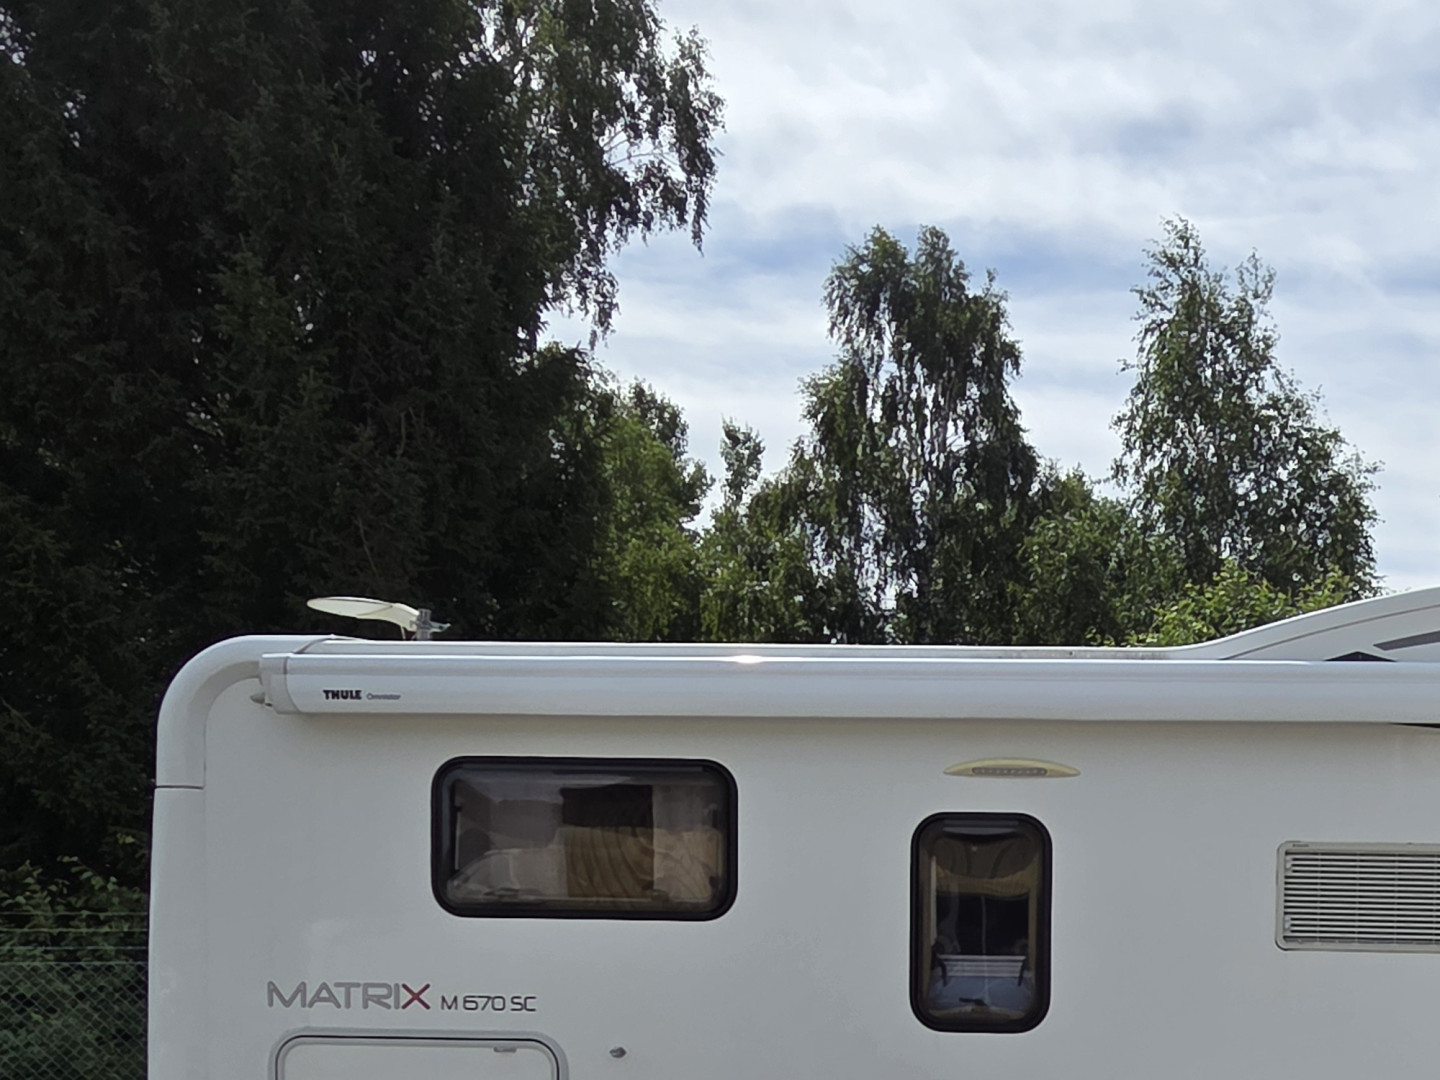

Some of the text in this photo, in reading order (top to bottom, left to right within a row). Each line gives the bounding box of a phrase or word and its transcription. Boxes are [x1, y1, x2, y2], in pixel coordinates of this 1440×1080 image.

[322, 689, 362, 700] THULE
[267, 981, 537, 1011] MATRIX M 670 SC
